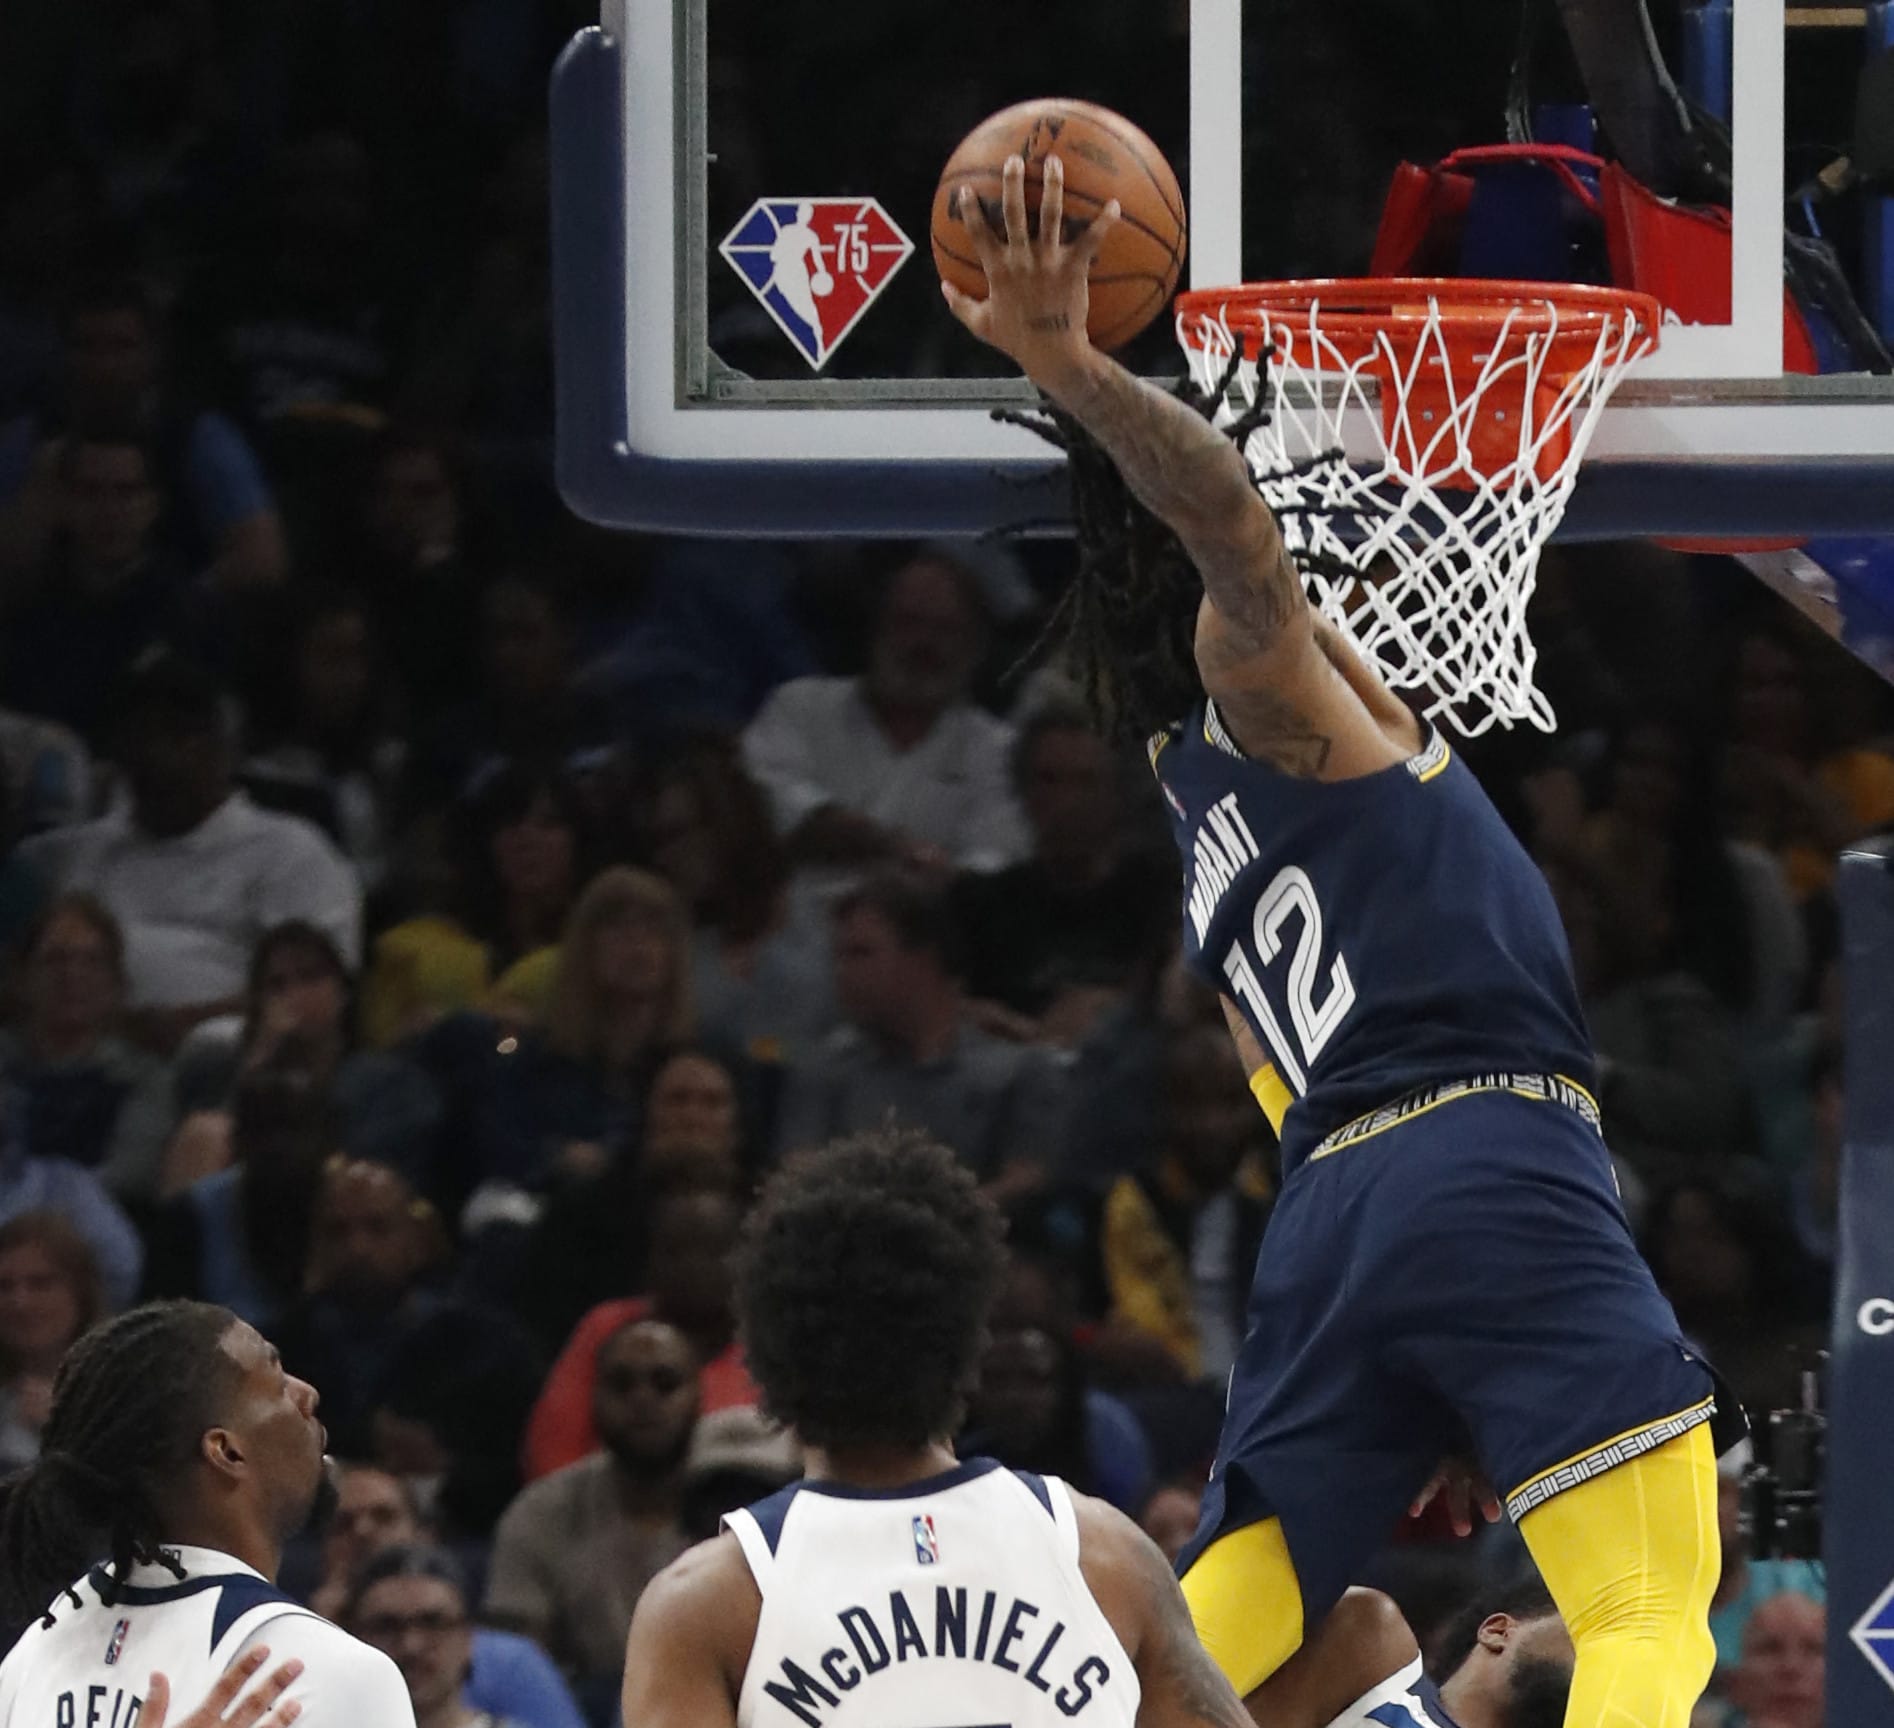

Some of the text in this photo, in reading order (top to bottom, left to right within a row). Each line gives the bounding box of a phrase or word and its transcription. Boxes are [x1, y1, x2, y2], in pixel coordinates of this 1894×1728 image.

[834, 224, 869, 273] 75
[1189, 792, 1260, 950] MORANT
[1223, 865, 1356, 1098] 12
